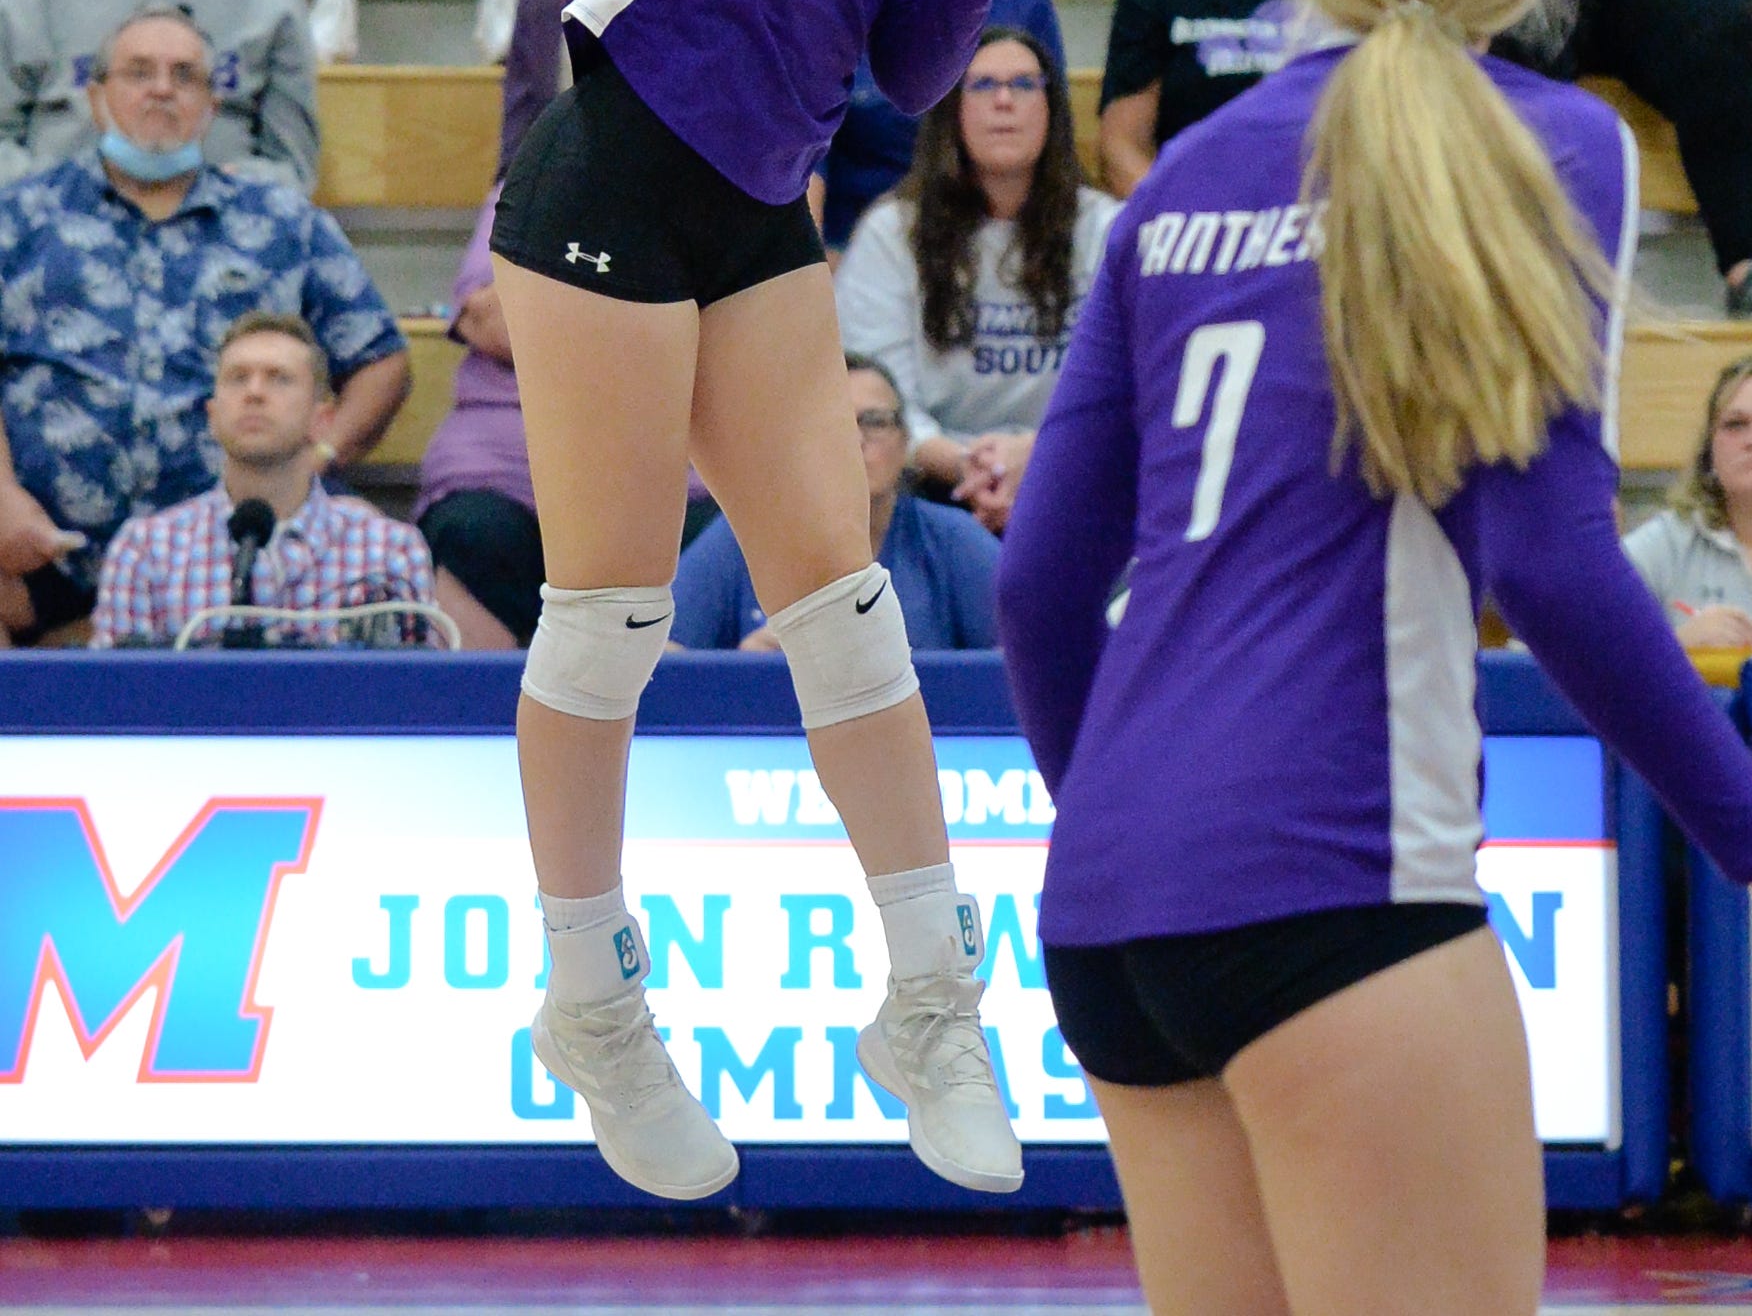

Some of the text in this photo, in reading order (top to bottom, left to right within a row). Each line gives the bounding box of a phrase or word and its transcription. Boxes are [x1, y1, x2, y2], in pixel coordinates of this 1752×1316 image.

[974, 344, 1068, 374] SOUT
[1171, 319, 1266, 543] 7
[0, 795, 326, 1084] M
[352, 893, 732, 989] JON
